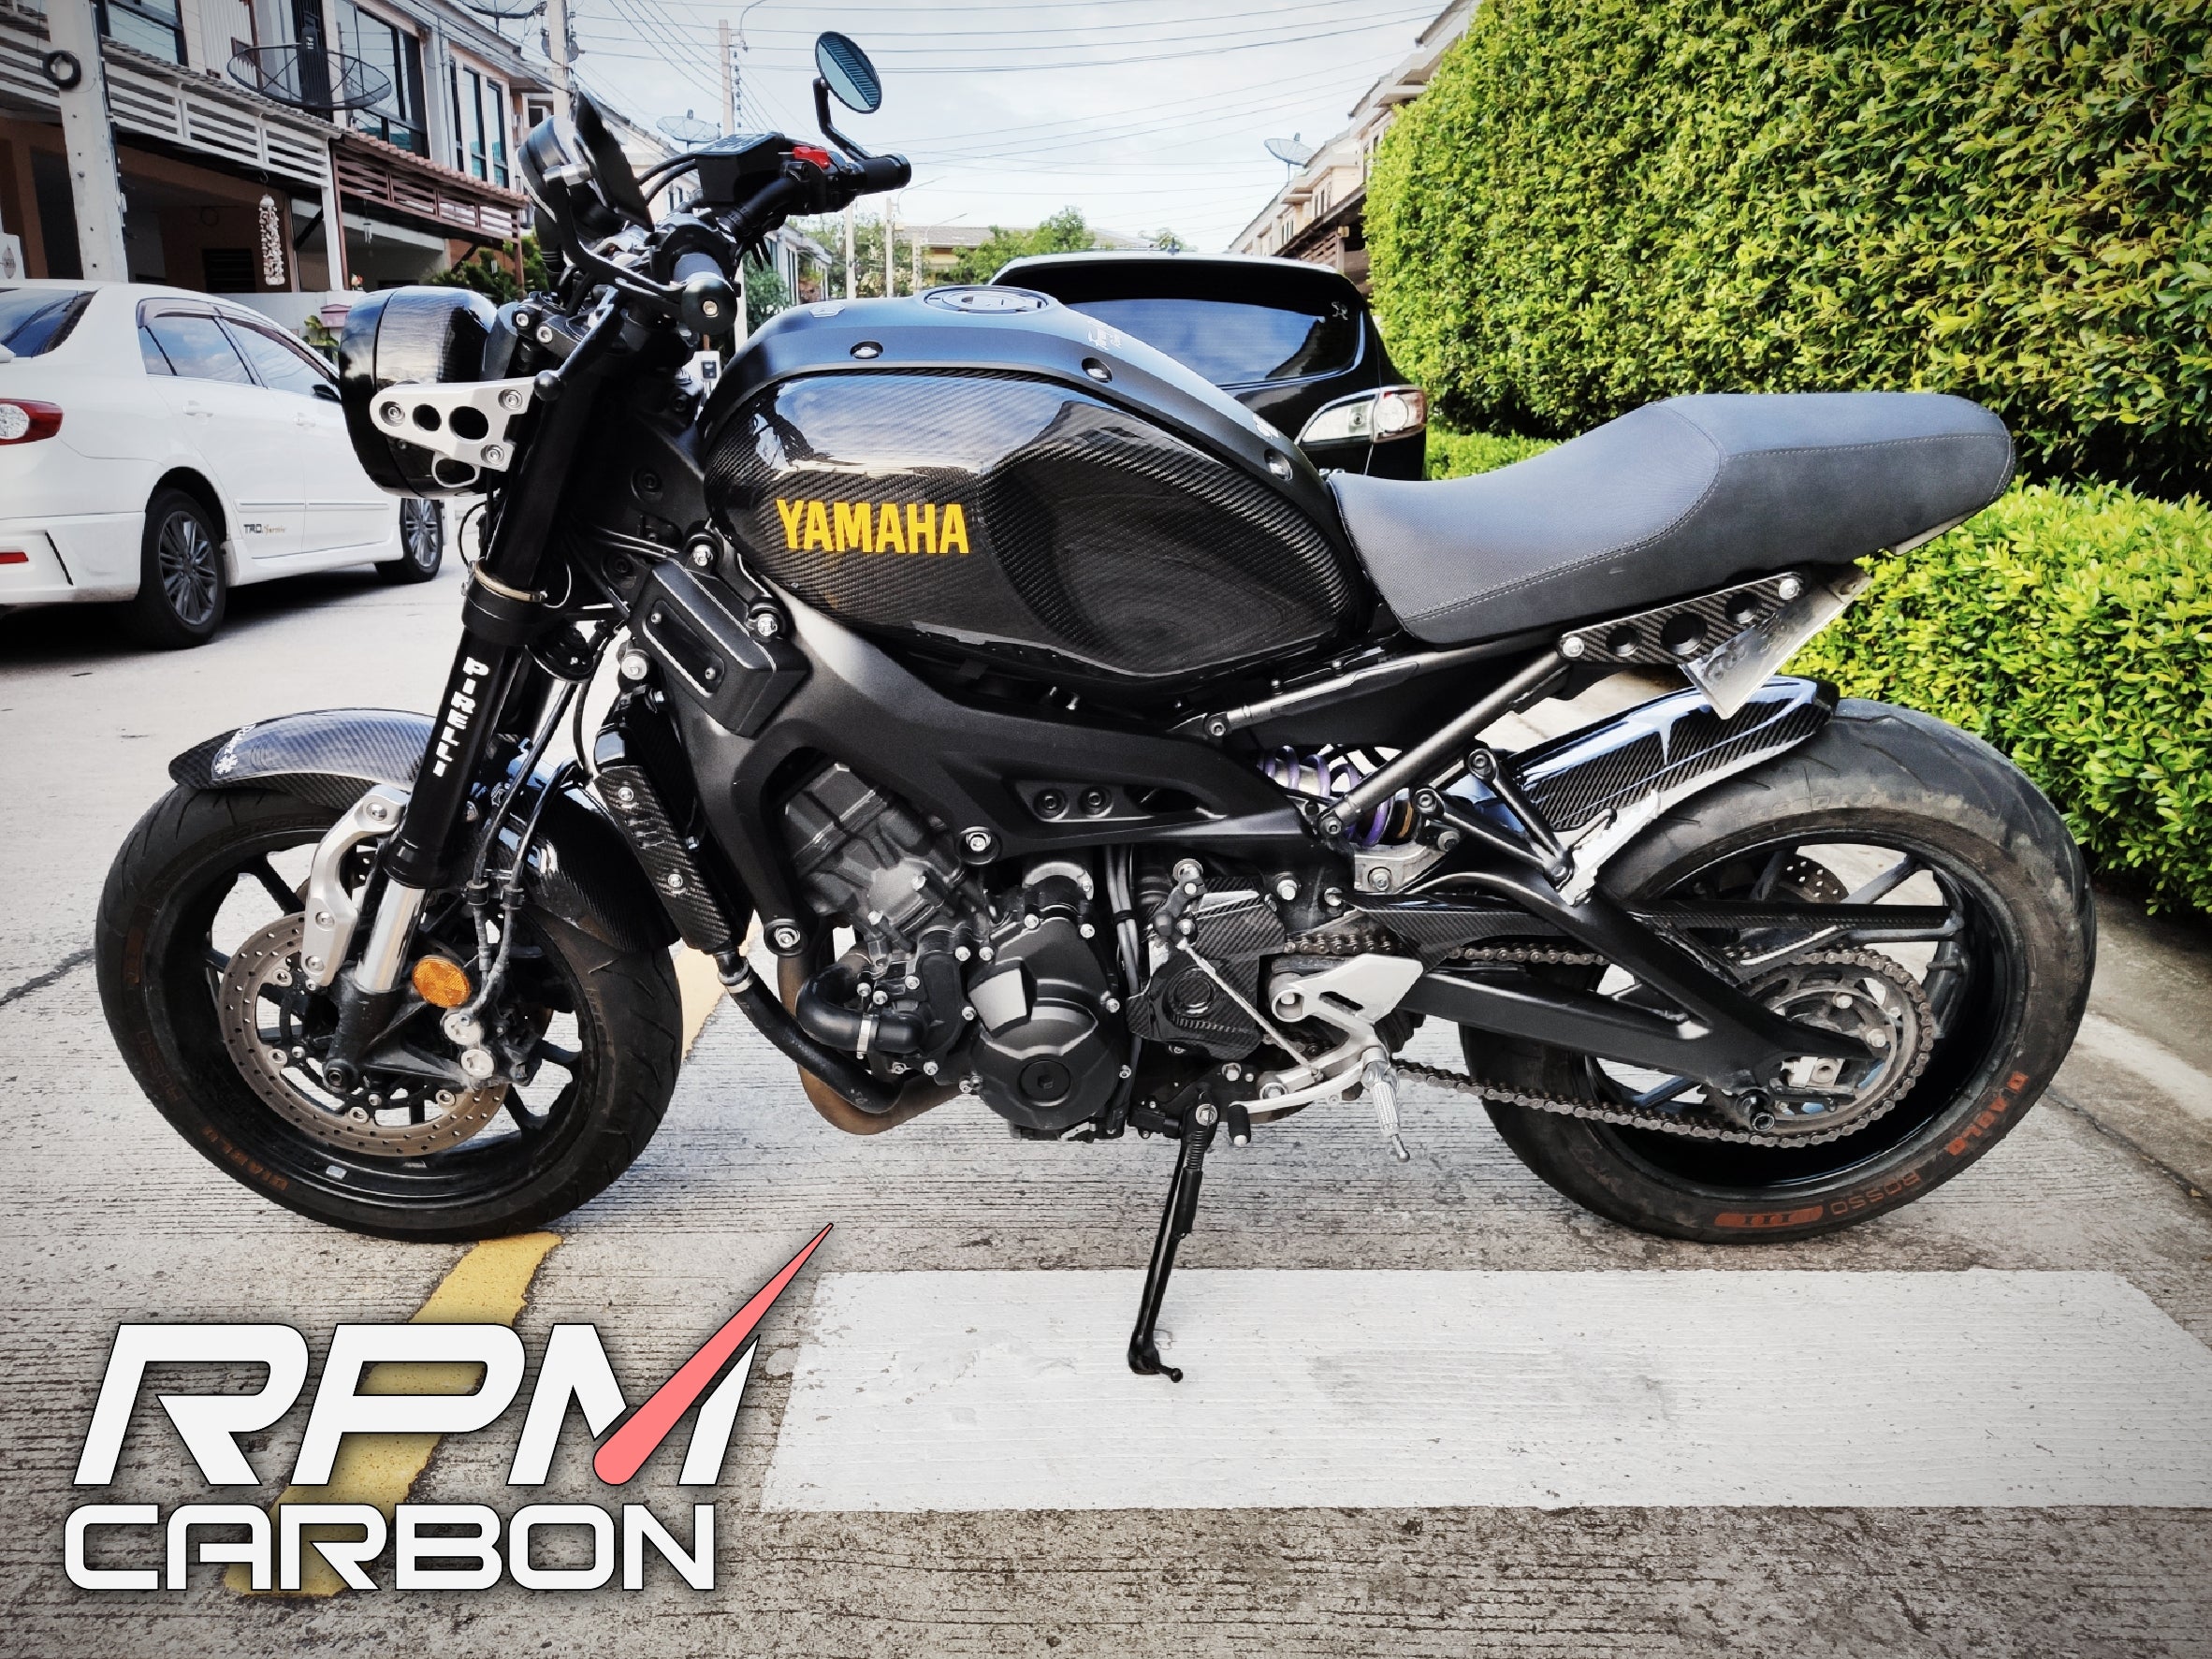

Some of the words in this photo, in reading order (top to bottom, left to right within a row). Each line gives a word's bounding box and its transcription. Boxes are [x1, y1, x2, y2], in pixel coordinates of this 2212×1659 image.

[776, 499, 969, 554] YAMAHA
[433, 657, 489, 778] PIRELLI
[202, 1125, 288, 1191] DIABLO
[1829, 1171, 1921, 1215] ROSSO
